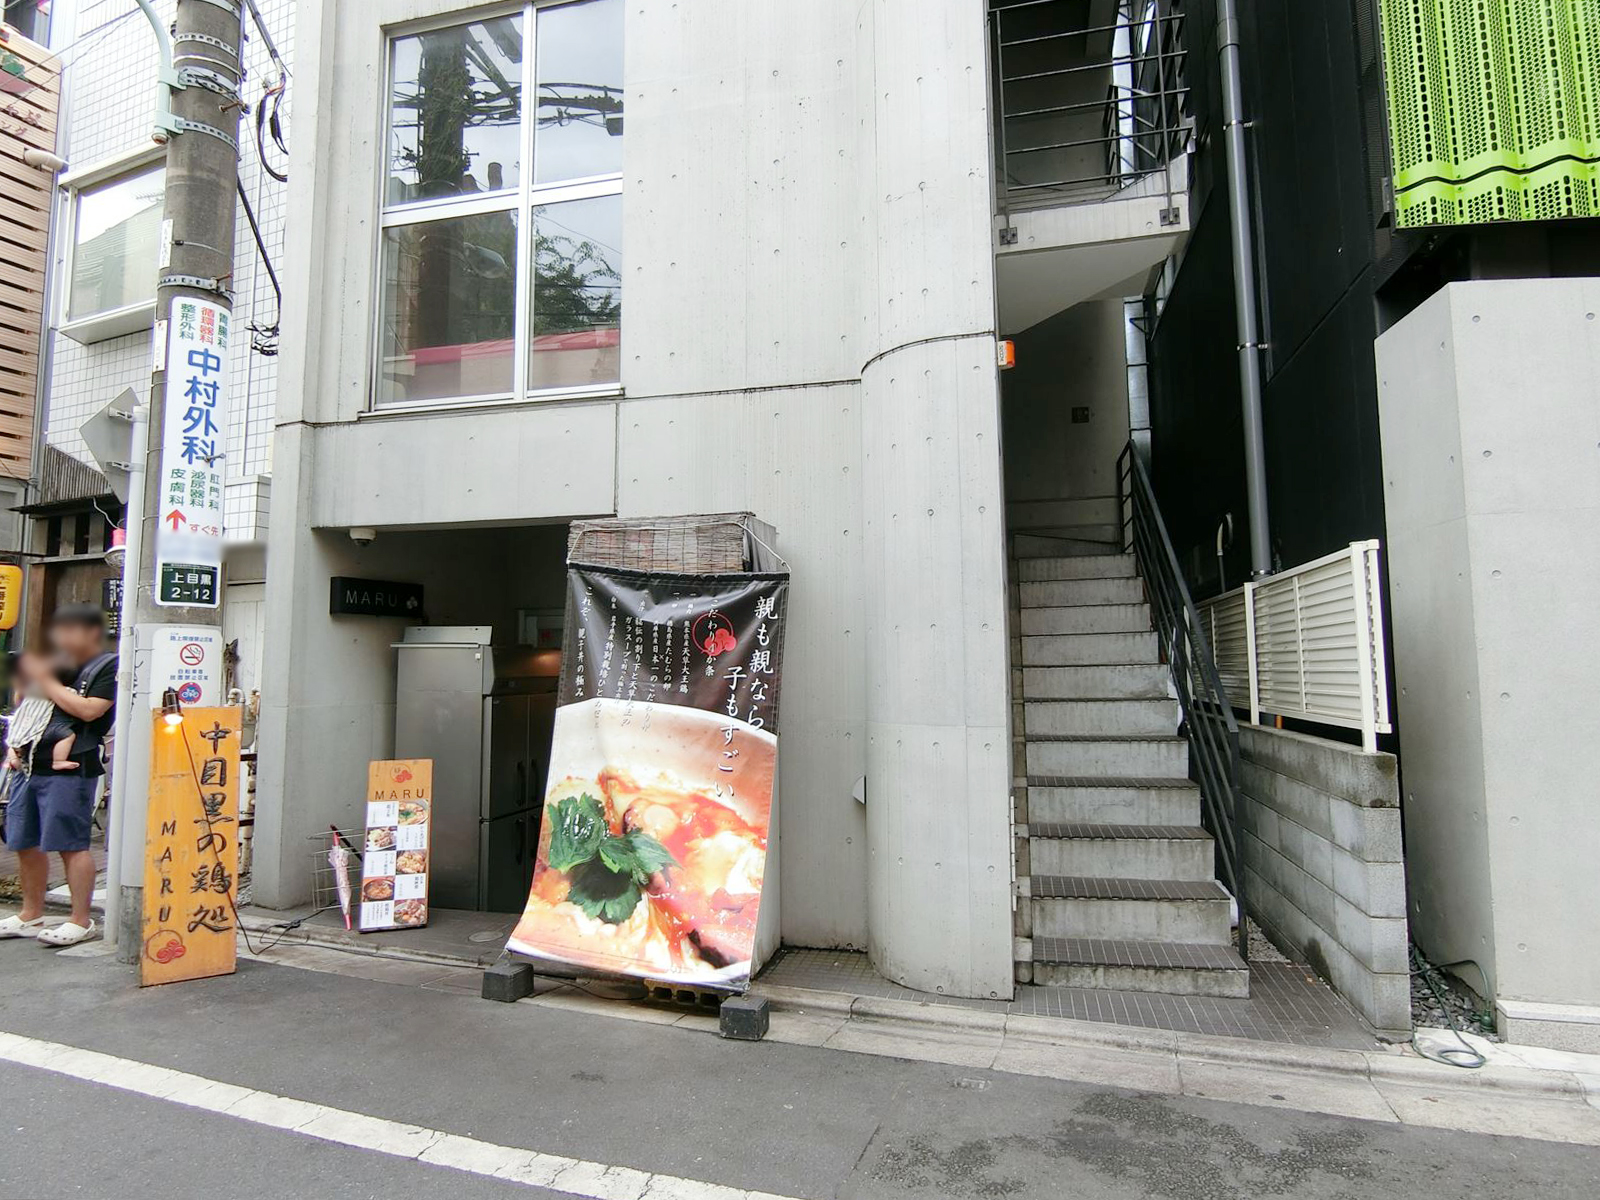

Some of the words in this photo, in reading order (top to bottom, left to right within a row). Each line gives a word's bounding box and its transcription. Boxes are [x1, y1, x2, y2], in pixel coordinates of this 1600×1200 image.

[180, 303, 196, 341] 整形外科
[200, 306, 215, 345] 循環器科
[217, 312, 229, 351] 胃腸科
[181, 348, 221, 468] 中村外科
[169, 468, 187, 507] 皮膚科
[190, 470, 206, 508] 泌尿器科
[208, 473, 220, 511] 肛門科
[190, 523, 219, 537] すぐ先
[171, 572, 212, 585] 上目黒
[171, 587, 210, 600] 2-12
[345, 589, 398, 607] MARU
[746, 596, 778, 731] 親も親なら
[714, 665, 747, 797] 子もすごい
[374, 788, 425, 800] MARU
[187, 720, 234, 933] 中目黒の鶏処
[157, 819, 177, 923] MARU
